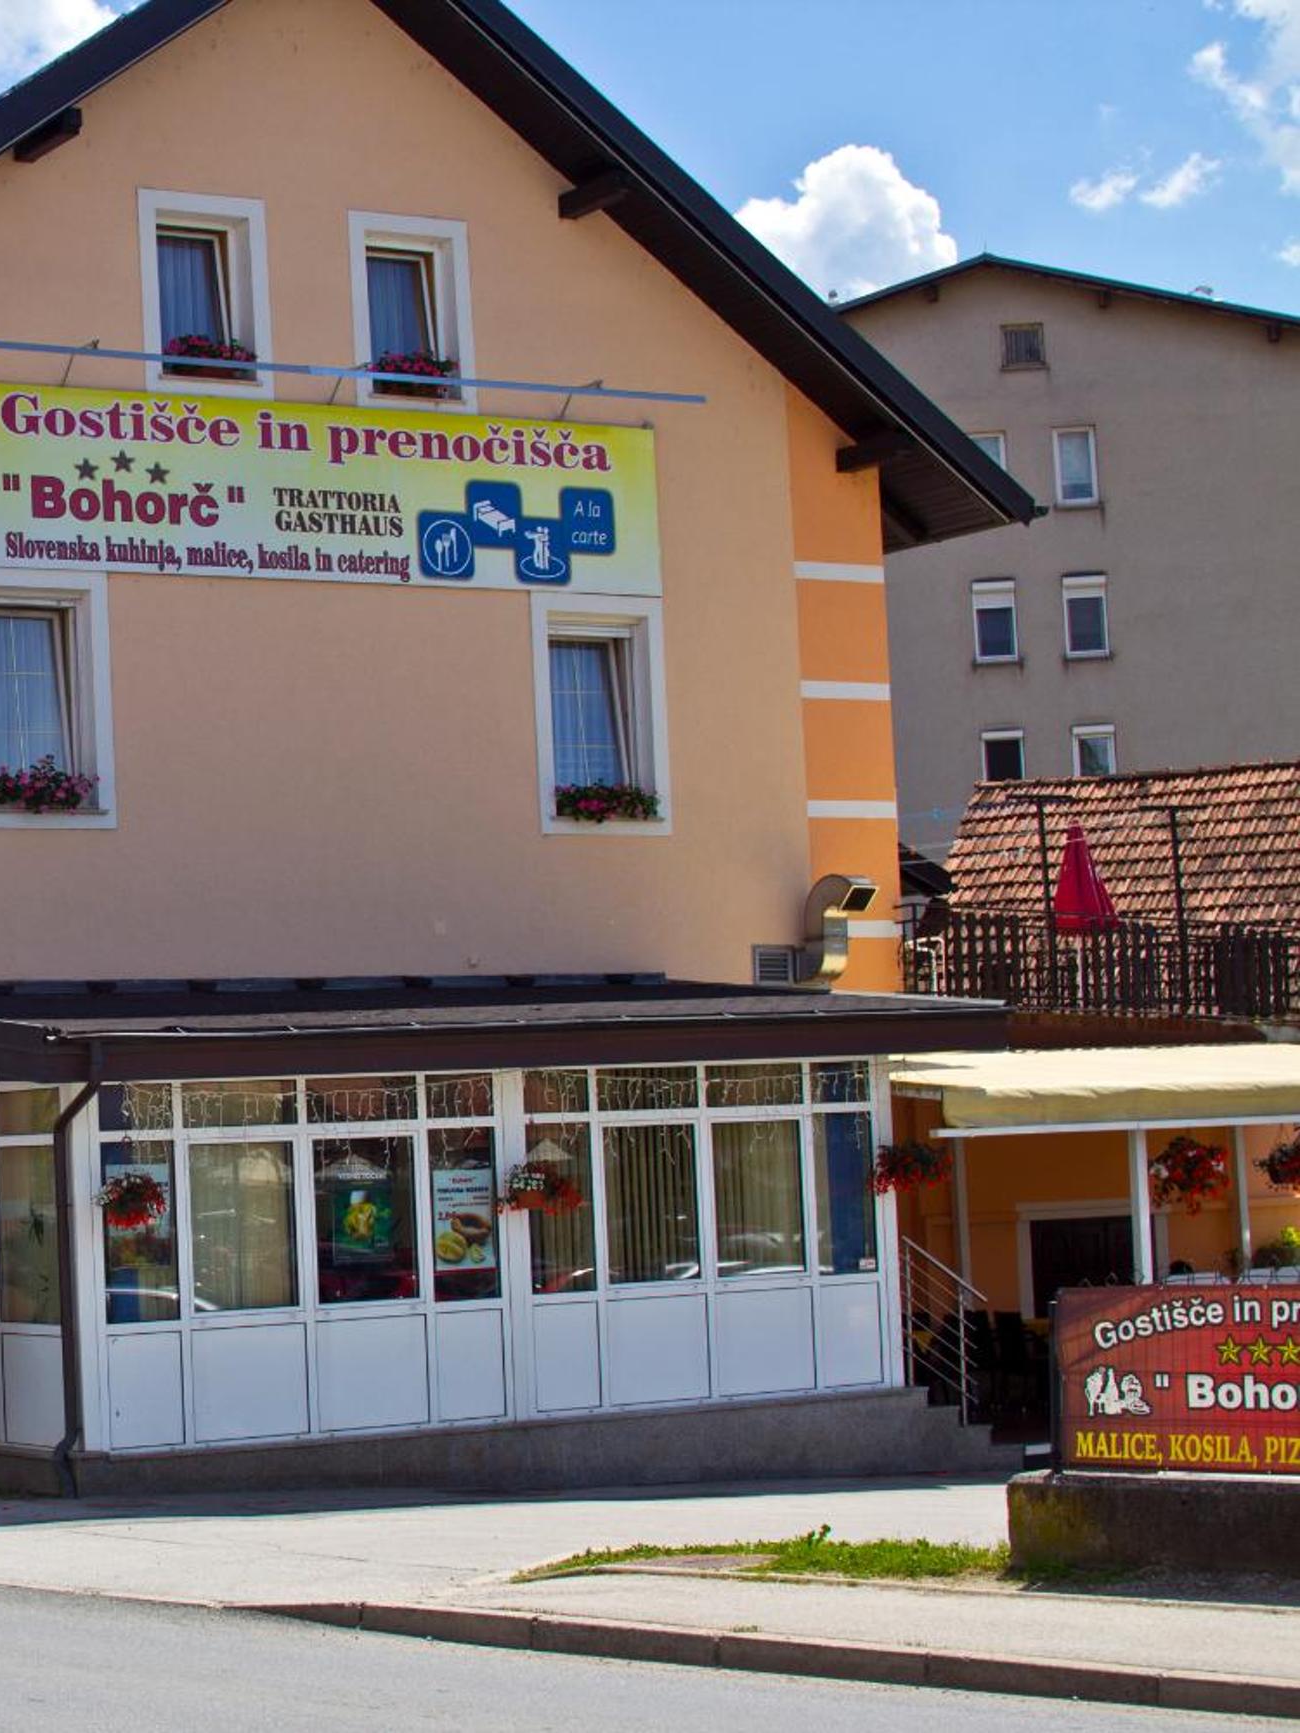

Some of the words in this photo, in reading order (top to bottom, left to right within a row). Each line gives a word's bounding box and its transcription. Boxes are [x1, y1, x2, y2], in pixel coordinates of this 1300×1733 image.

[0, 393, 240, 447] Gostišče
[258, 411, 312, 451] in
[327, 424, 612, 472] prenočišča
[273, 486, 401, 514] TRATTORIA
[573, 500, 585, 518] A
[587, 500, 601, 518] la
[274, 509, 404, 538] GASTHAUS
[571, 530, 607, 546] carte
[5, 531, 101, 561] Slovenska
[105, 535, 183, 571] kuhinja,
[186, 540, 254, 573] malice,
[257, 543, 311, 572] kosila
[315, 547, 332, 573] in
[337, 549, 411, 583] catering
[1093, 1296, 1225, 1349] Gostišče
[1233, 1295, 1261, 1322] in
[1154, 1373, 1300, 1411] "Boho
[1075, 1431, 1164, 1466] MALICE,
[1169, 1434, 1259, 1469] KOSILA,
